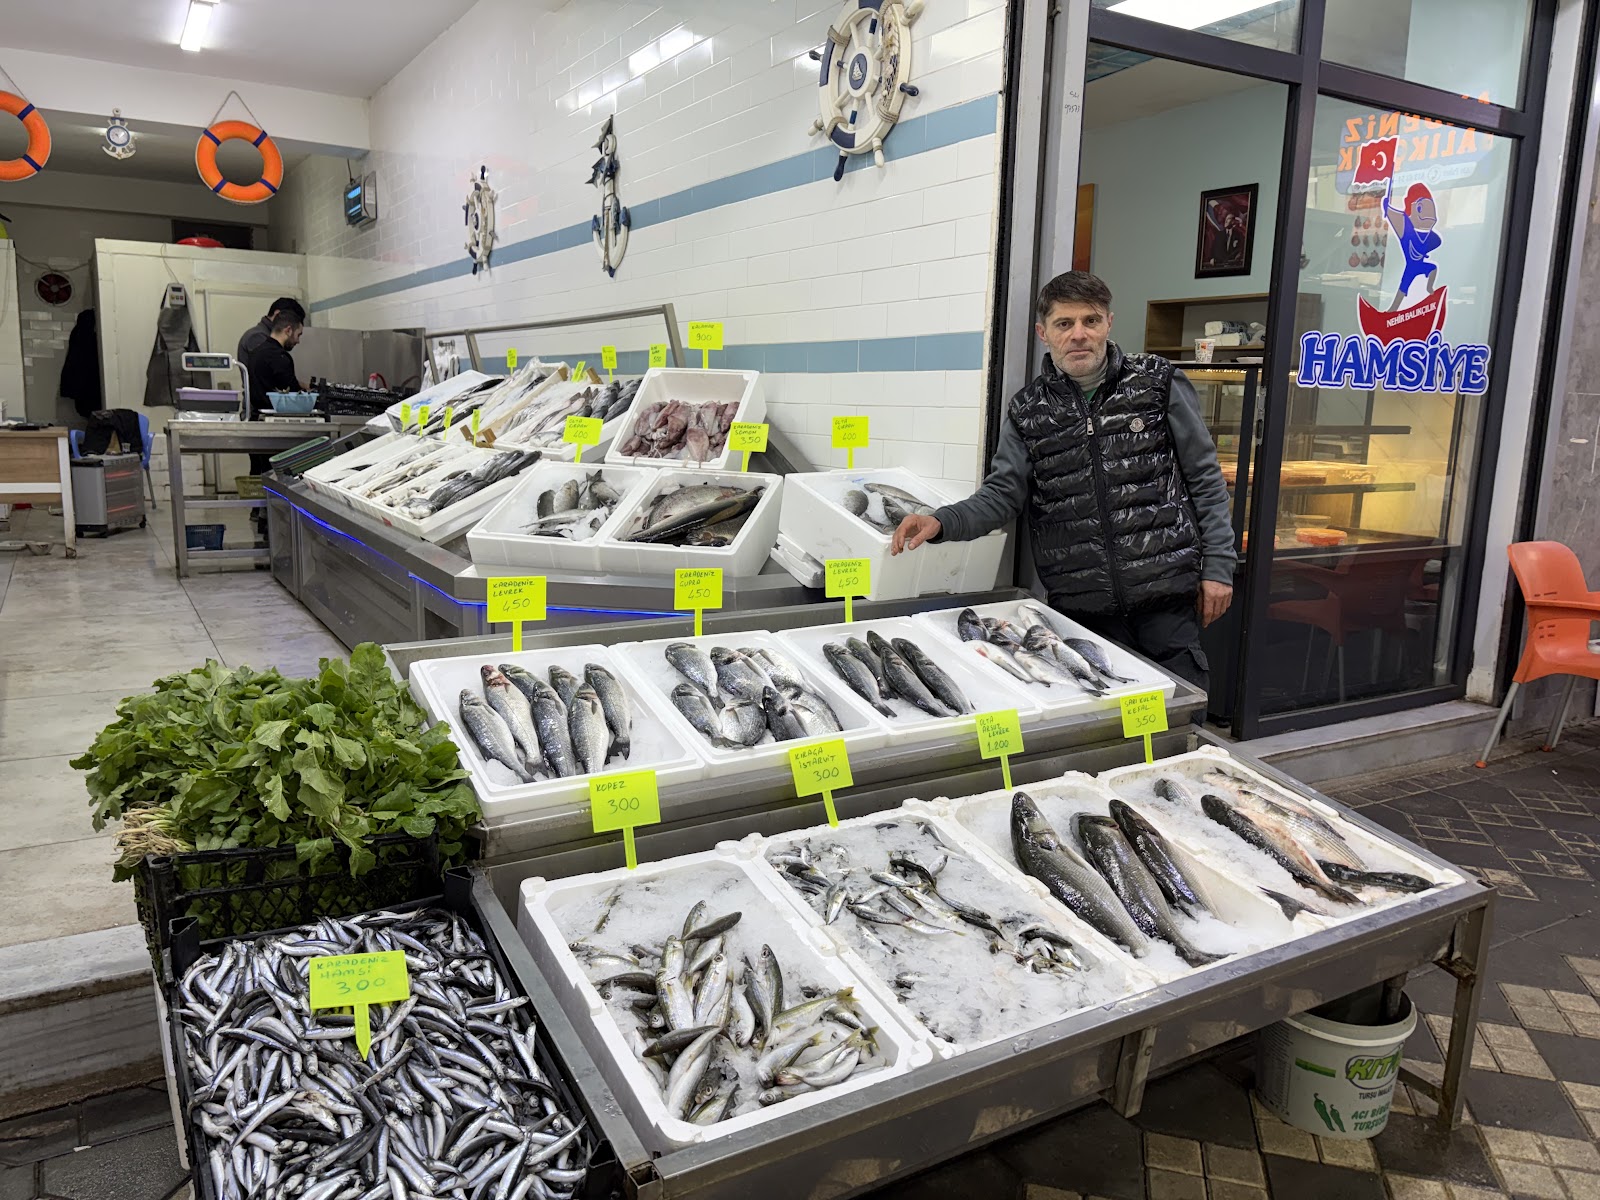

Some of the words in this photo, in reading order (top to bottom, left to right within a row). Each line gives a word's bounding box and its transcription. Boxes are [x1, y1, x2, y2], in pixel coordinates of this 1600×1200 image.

[1386, 314, 1405, 328] NEHİR
[1405, 302, 1437, 321] BALIKÇILIK
[696, 333, 712, 341] 900
[1297, 330, 1491, 395] HAMSİYE
[740, 436, 762, 445] 350
[492, 579, 536, 589] KARADENİZ
[838, 576, 859, 589] 450
[492, 588, 524, 598] LEVREK
[687, 588, 711, 600] 450
[502, 597, 531, 612] 450
[1135, 713, 1157, 729] 350
[812, 766, 840, 783] 300
[596, 780, 627, 792] KOPEZ
[607, 797, 640, 815] 300
[316, 955, 391, 970] KARADENİZ
[320, 965, 372, 979] HAMSİ
[335, 977, 386, 995] 300
[1351, 1110, 1369, 1120] ACI
